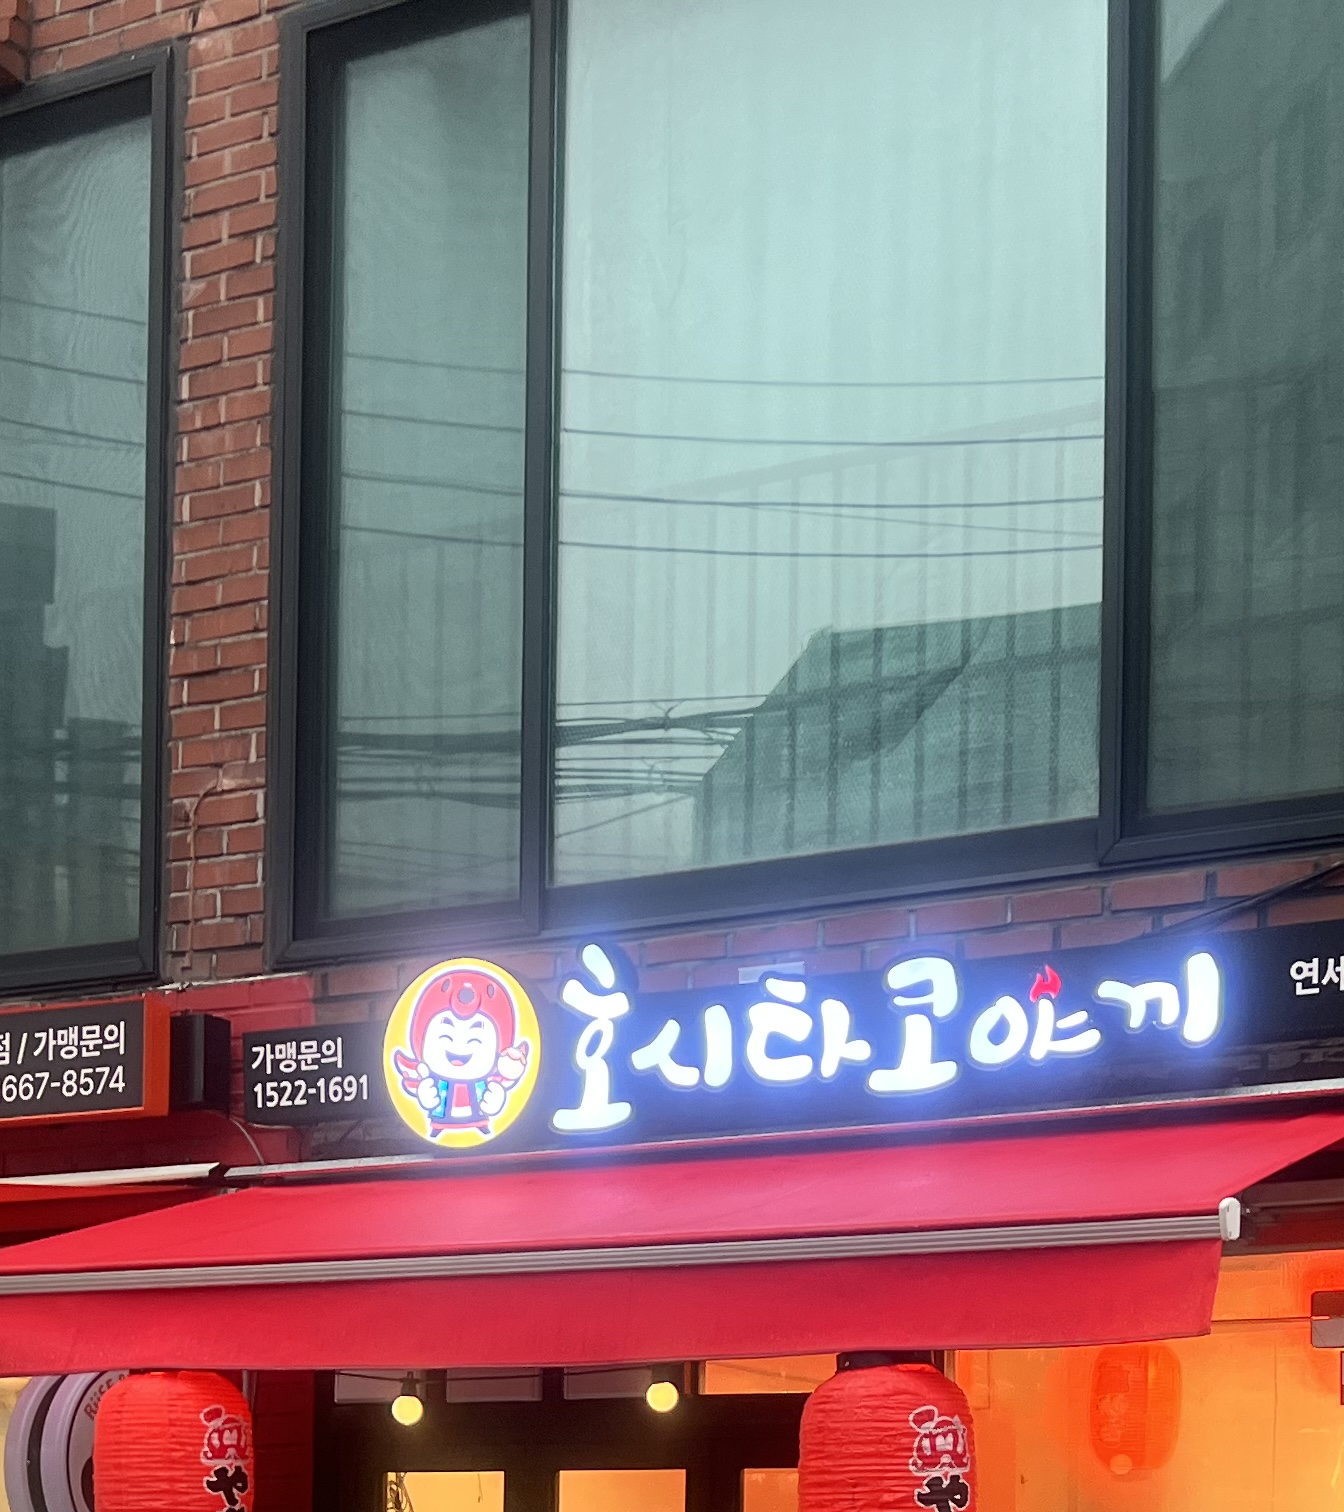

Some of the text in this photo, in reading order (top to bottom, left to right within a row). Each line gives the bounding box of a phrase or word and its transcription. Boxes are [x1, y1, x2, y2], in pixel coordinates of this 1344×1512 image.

[33, 1020, 127, 1062] 가맹문의
[250, 1036, 344, 1075] 가맹문의
[252, 1074, 370, 1109] 1522-1691
